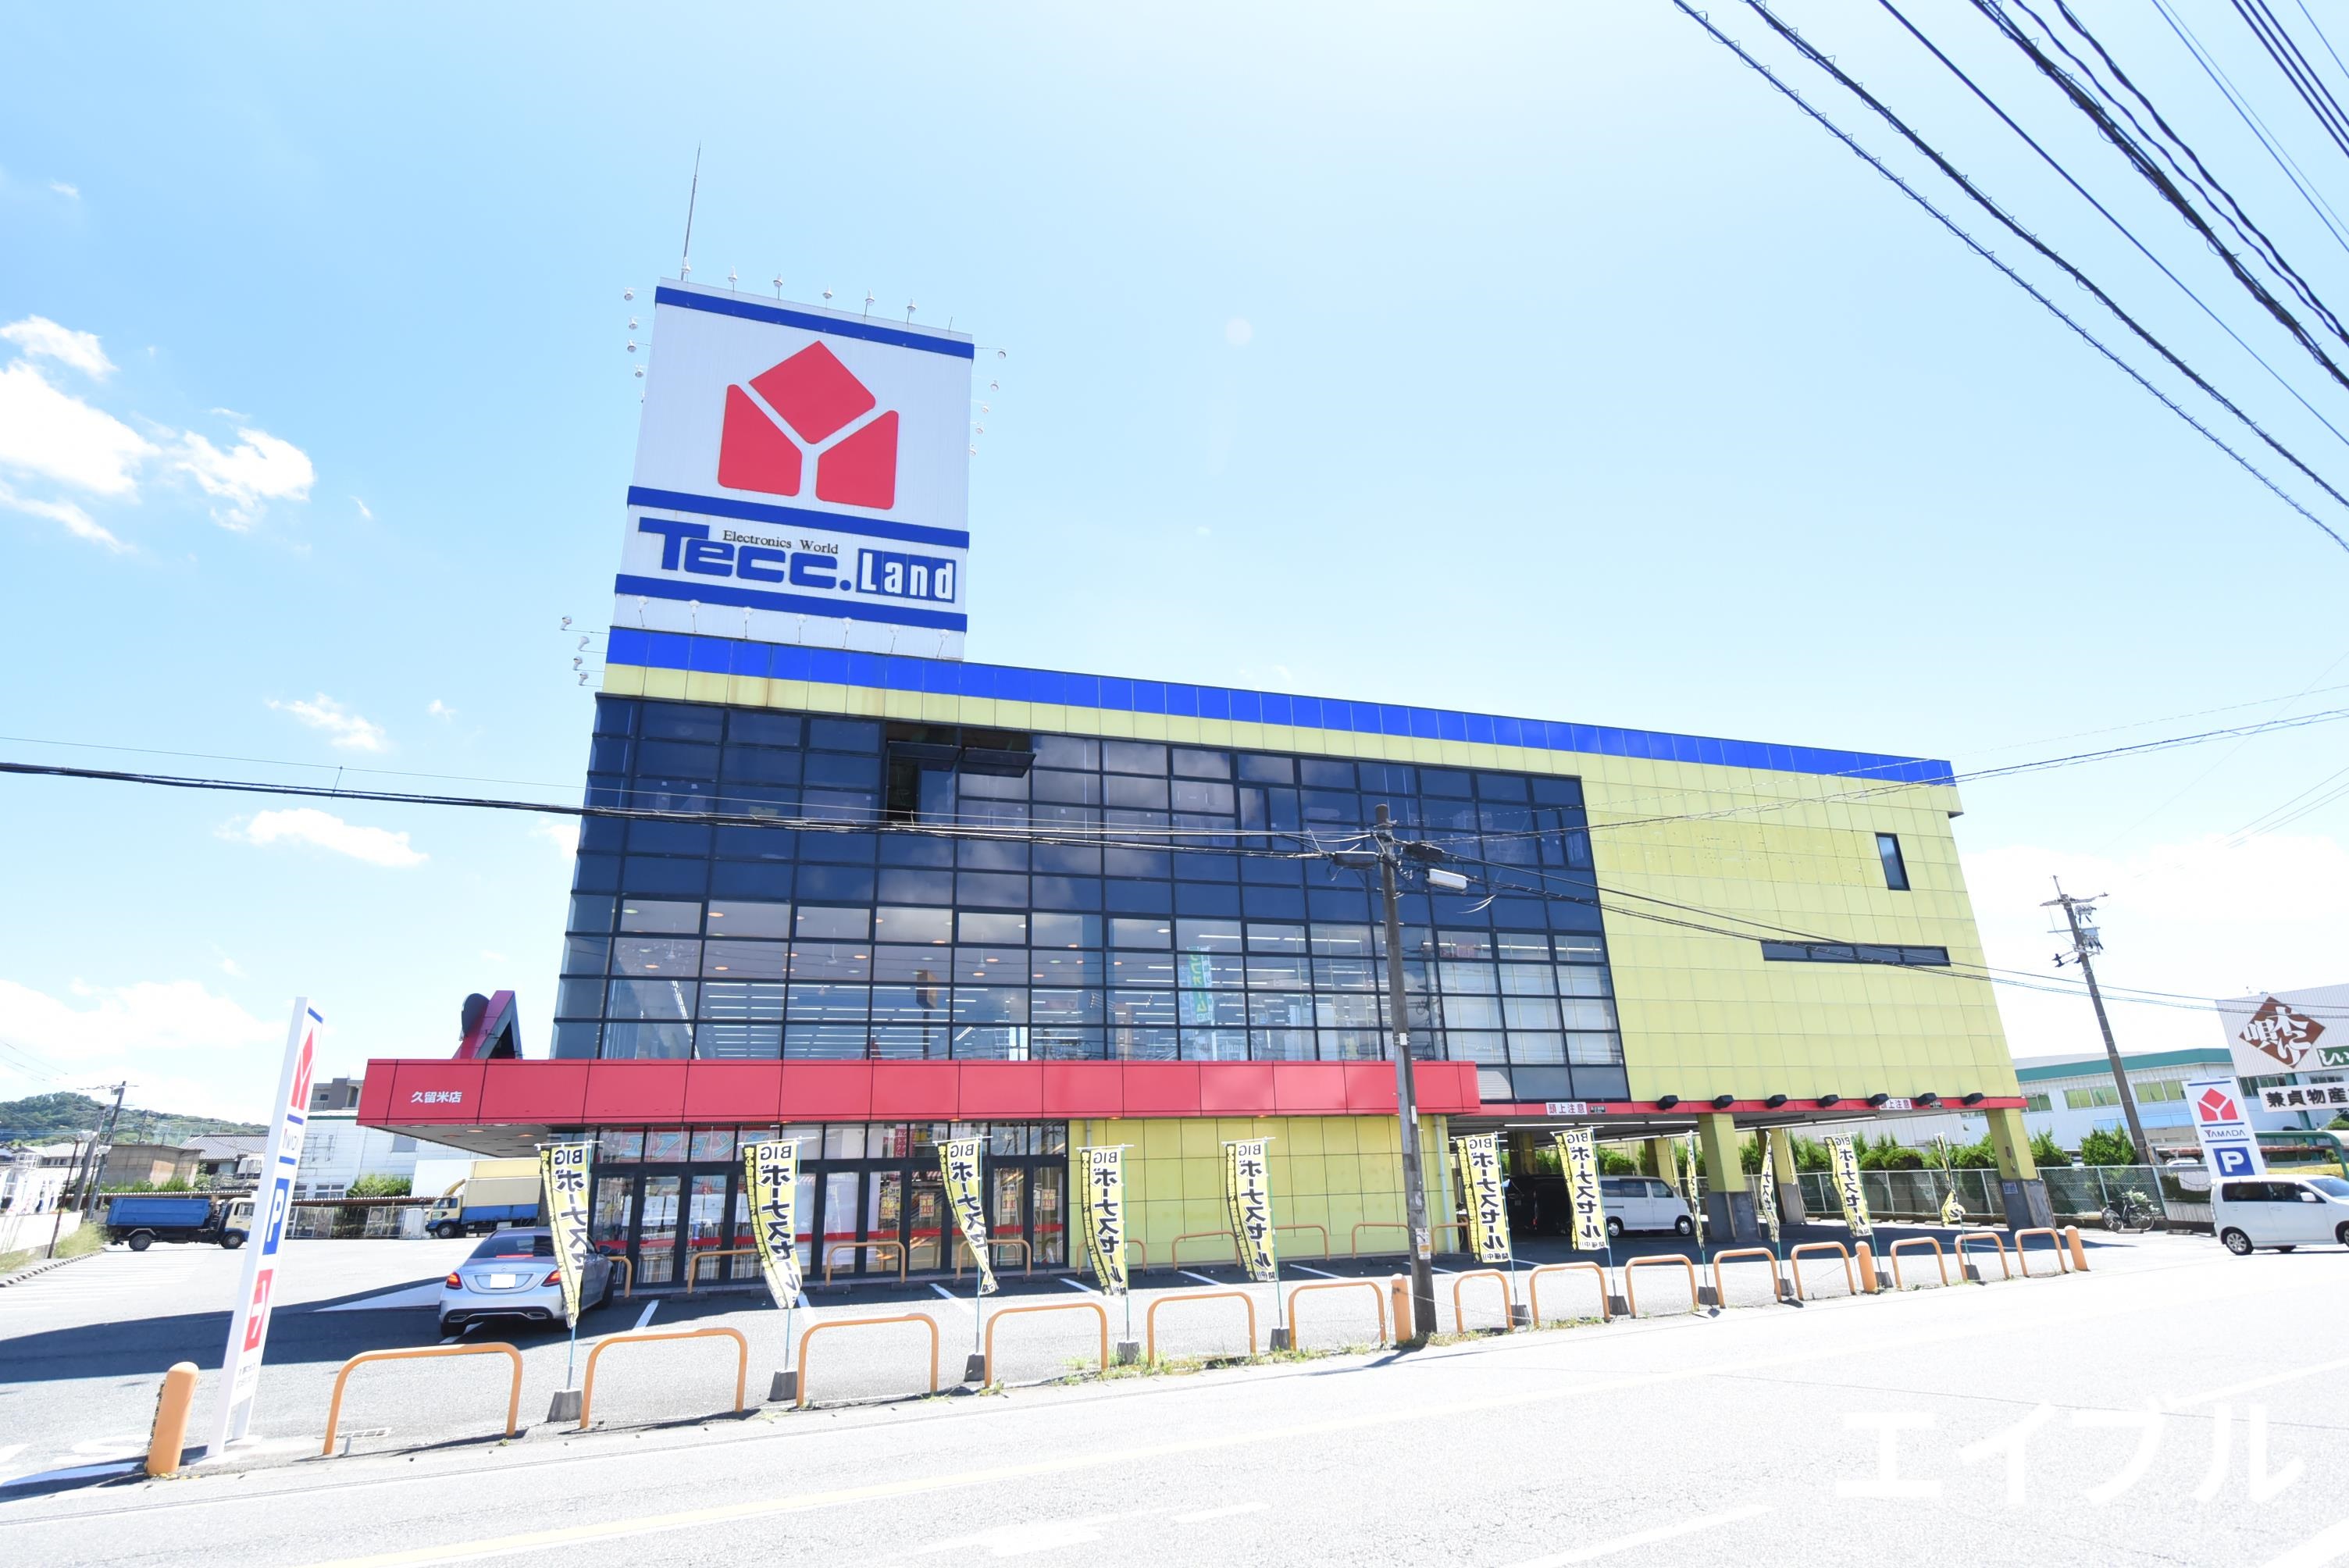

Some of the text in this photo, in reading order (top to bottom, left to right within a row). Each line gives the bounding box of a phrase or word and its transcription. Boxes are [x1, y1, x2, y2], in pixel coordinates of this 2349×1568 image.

[722, 529, 839, 554] Electronics World
[411, 1090, 463, 1103] 久留米店
[2265, 1086, 2349, 1107] 兼貞物産
[1549, 1103, 1585, 1114] 頭上注意
[2204, 1129, 2246, 1138] YAMADA
[2220, 1151, 2244, 1173] P
[267, 1188, 286, 1243] P
